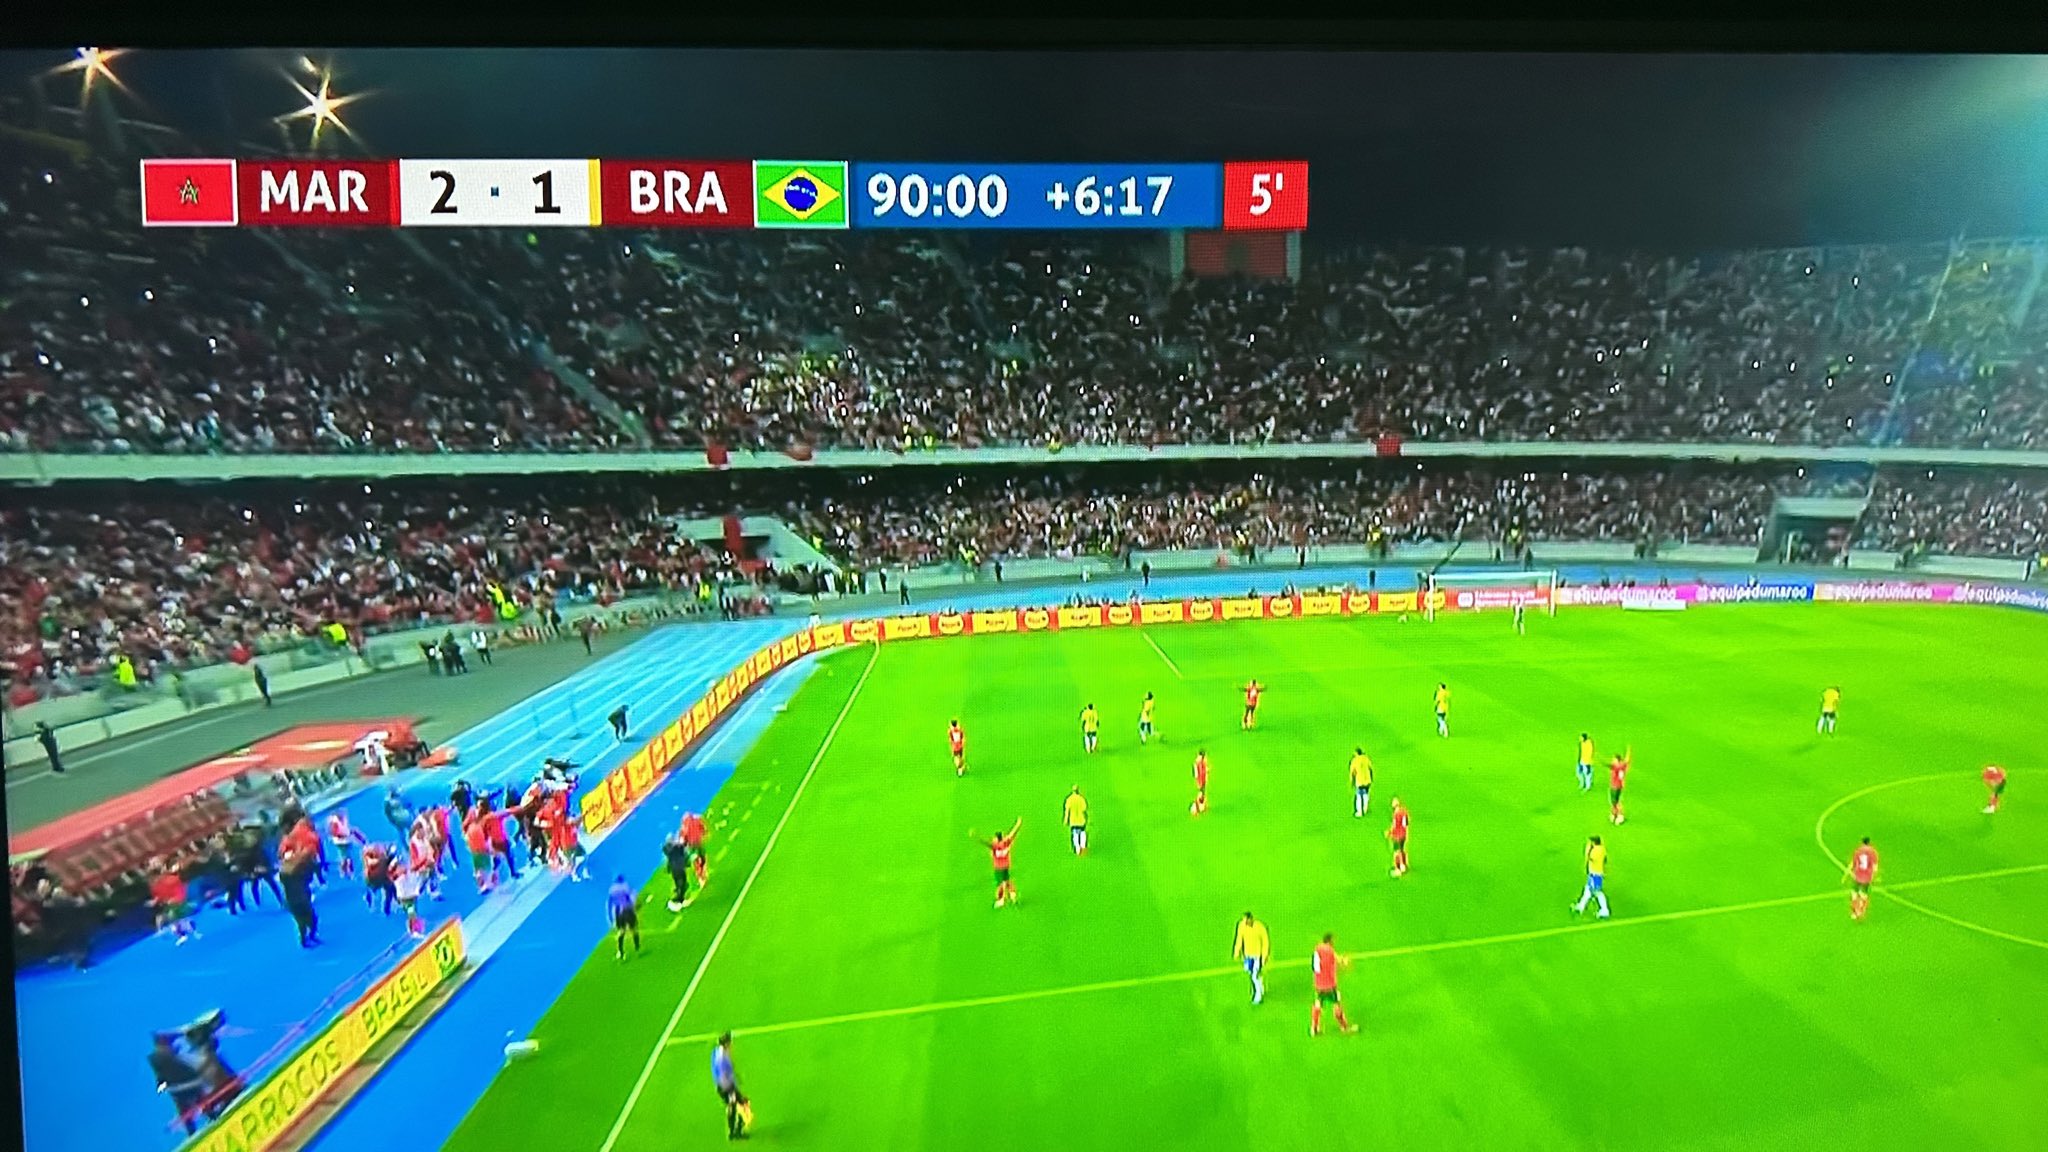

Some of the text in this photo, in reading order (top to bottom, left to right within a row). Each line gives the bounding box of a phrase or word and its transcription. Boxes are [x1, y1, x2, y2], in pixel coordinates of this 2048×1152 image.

[260, 169, 1284, 218] MAR 2 1 BRA 90:00 +6:17 5'
